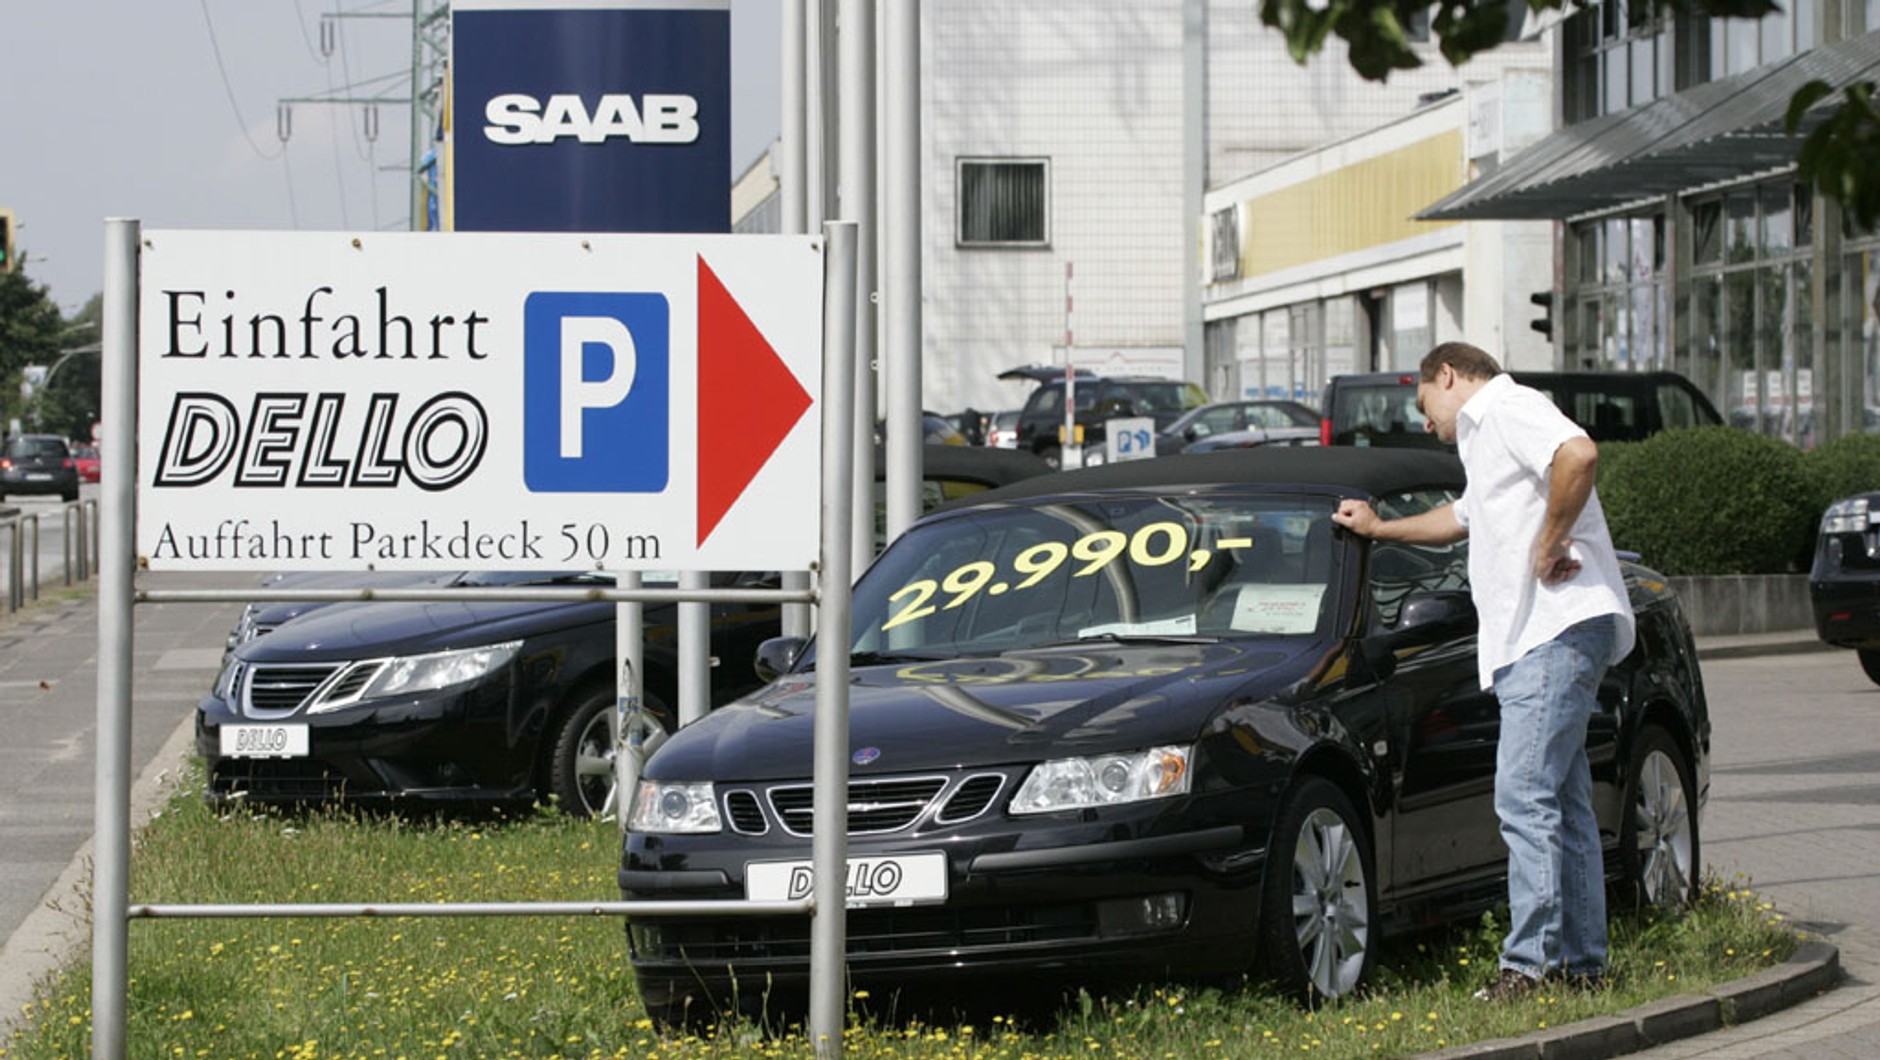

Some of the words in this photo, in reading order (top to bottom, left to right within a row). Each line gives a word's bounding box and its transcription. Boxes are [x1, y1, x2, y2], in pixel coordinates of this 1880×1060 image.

[484, 93, 699, 144] SAAB
[160, 287, 490, 361] Einfahrt
[560, 317, 637, 458] P
[153, 391, 489, 493] DELLO
[153, 520, 334, 560] Auffahrt
[349, 520, 543, 560] Parkdeck
[560, 521, 610, 560] 50
[625, 532, 662, 560] m
[882, 522, 1253, 632] 29.990,-
[235, 727, 287, 751] DELLO
[788, 860, 903, 901] DLO
